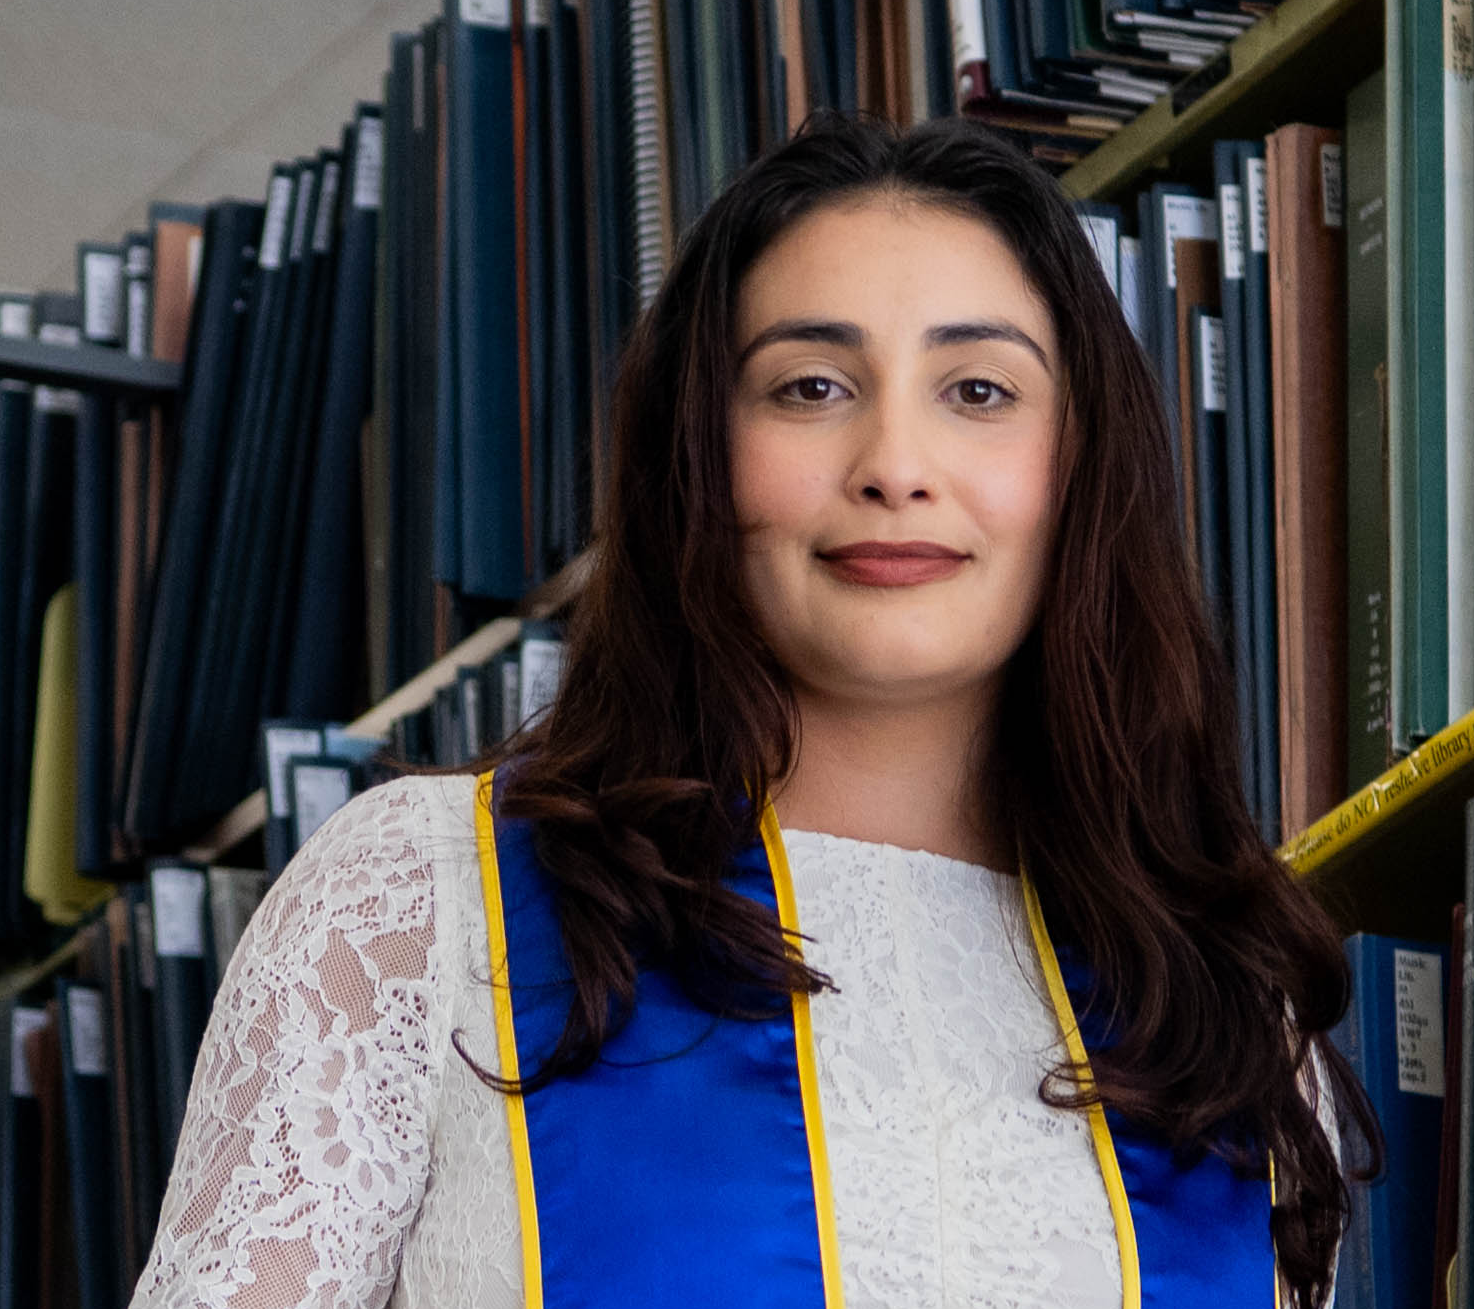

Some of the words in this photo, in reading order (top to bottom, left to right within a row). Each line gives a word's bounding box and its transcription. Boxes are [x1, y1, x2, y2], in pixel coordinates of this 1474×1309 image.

[1335, 810, 1351, 834] do
[1354, 783, 1384, 827] NOT
[1431, 728, 1471, 769] library
